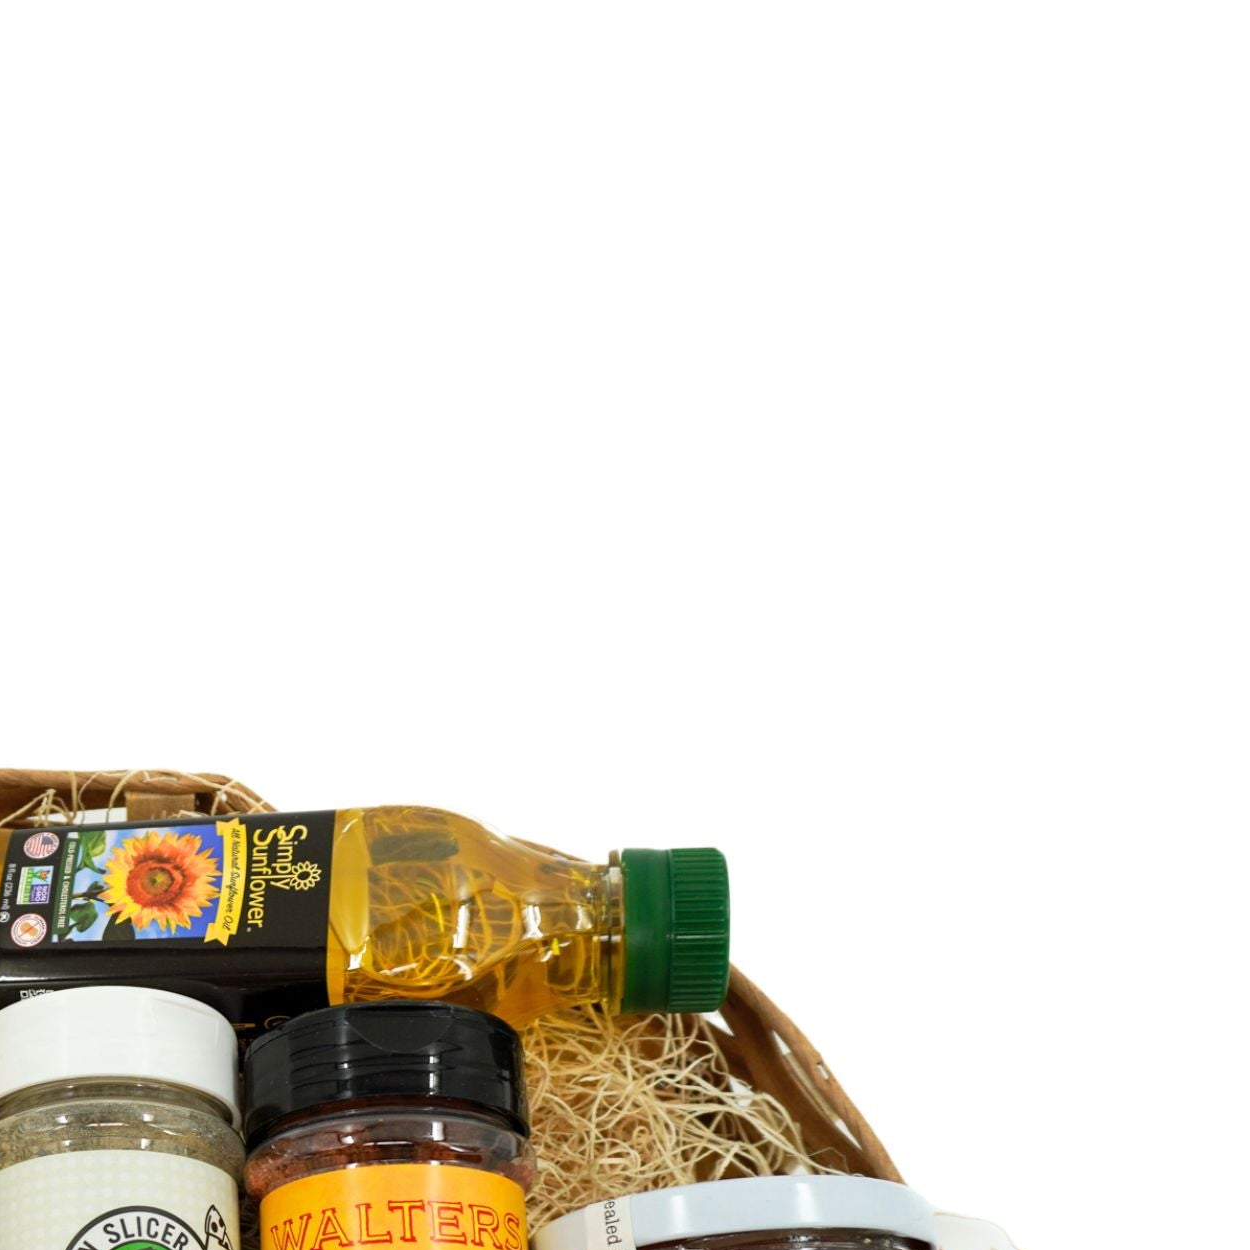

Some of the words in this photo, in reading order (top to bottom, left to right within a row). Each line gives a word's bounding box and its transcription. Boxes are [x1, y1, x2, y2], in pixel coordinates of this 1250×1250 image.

[231, 828, 241, 839] All
[62, 841, 76, 874] COLD-PRESSED
[230, 840, 241, 870] Natural
[269, 825, 309, 890] Simply
[2, 882, 15, 897] (236
[247, 828, 284, 928] Sunflower
[34, 885, 42, 902] GMO
[58, 880, 70, 915] CHOLESTEROL
[225, 871, 240, 914] Sunflower
[0, 899, 10, 910] ml)
[56, 916, 67, 929] FREE
[221, 915, 234, 932] Oil
